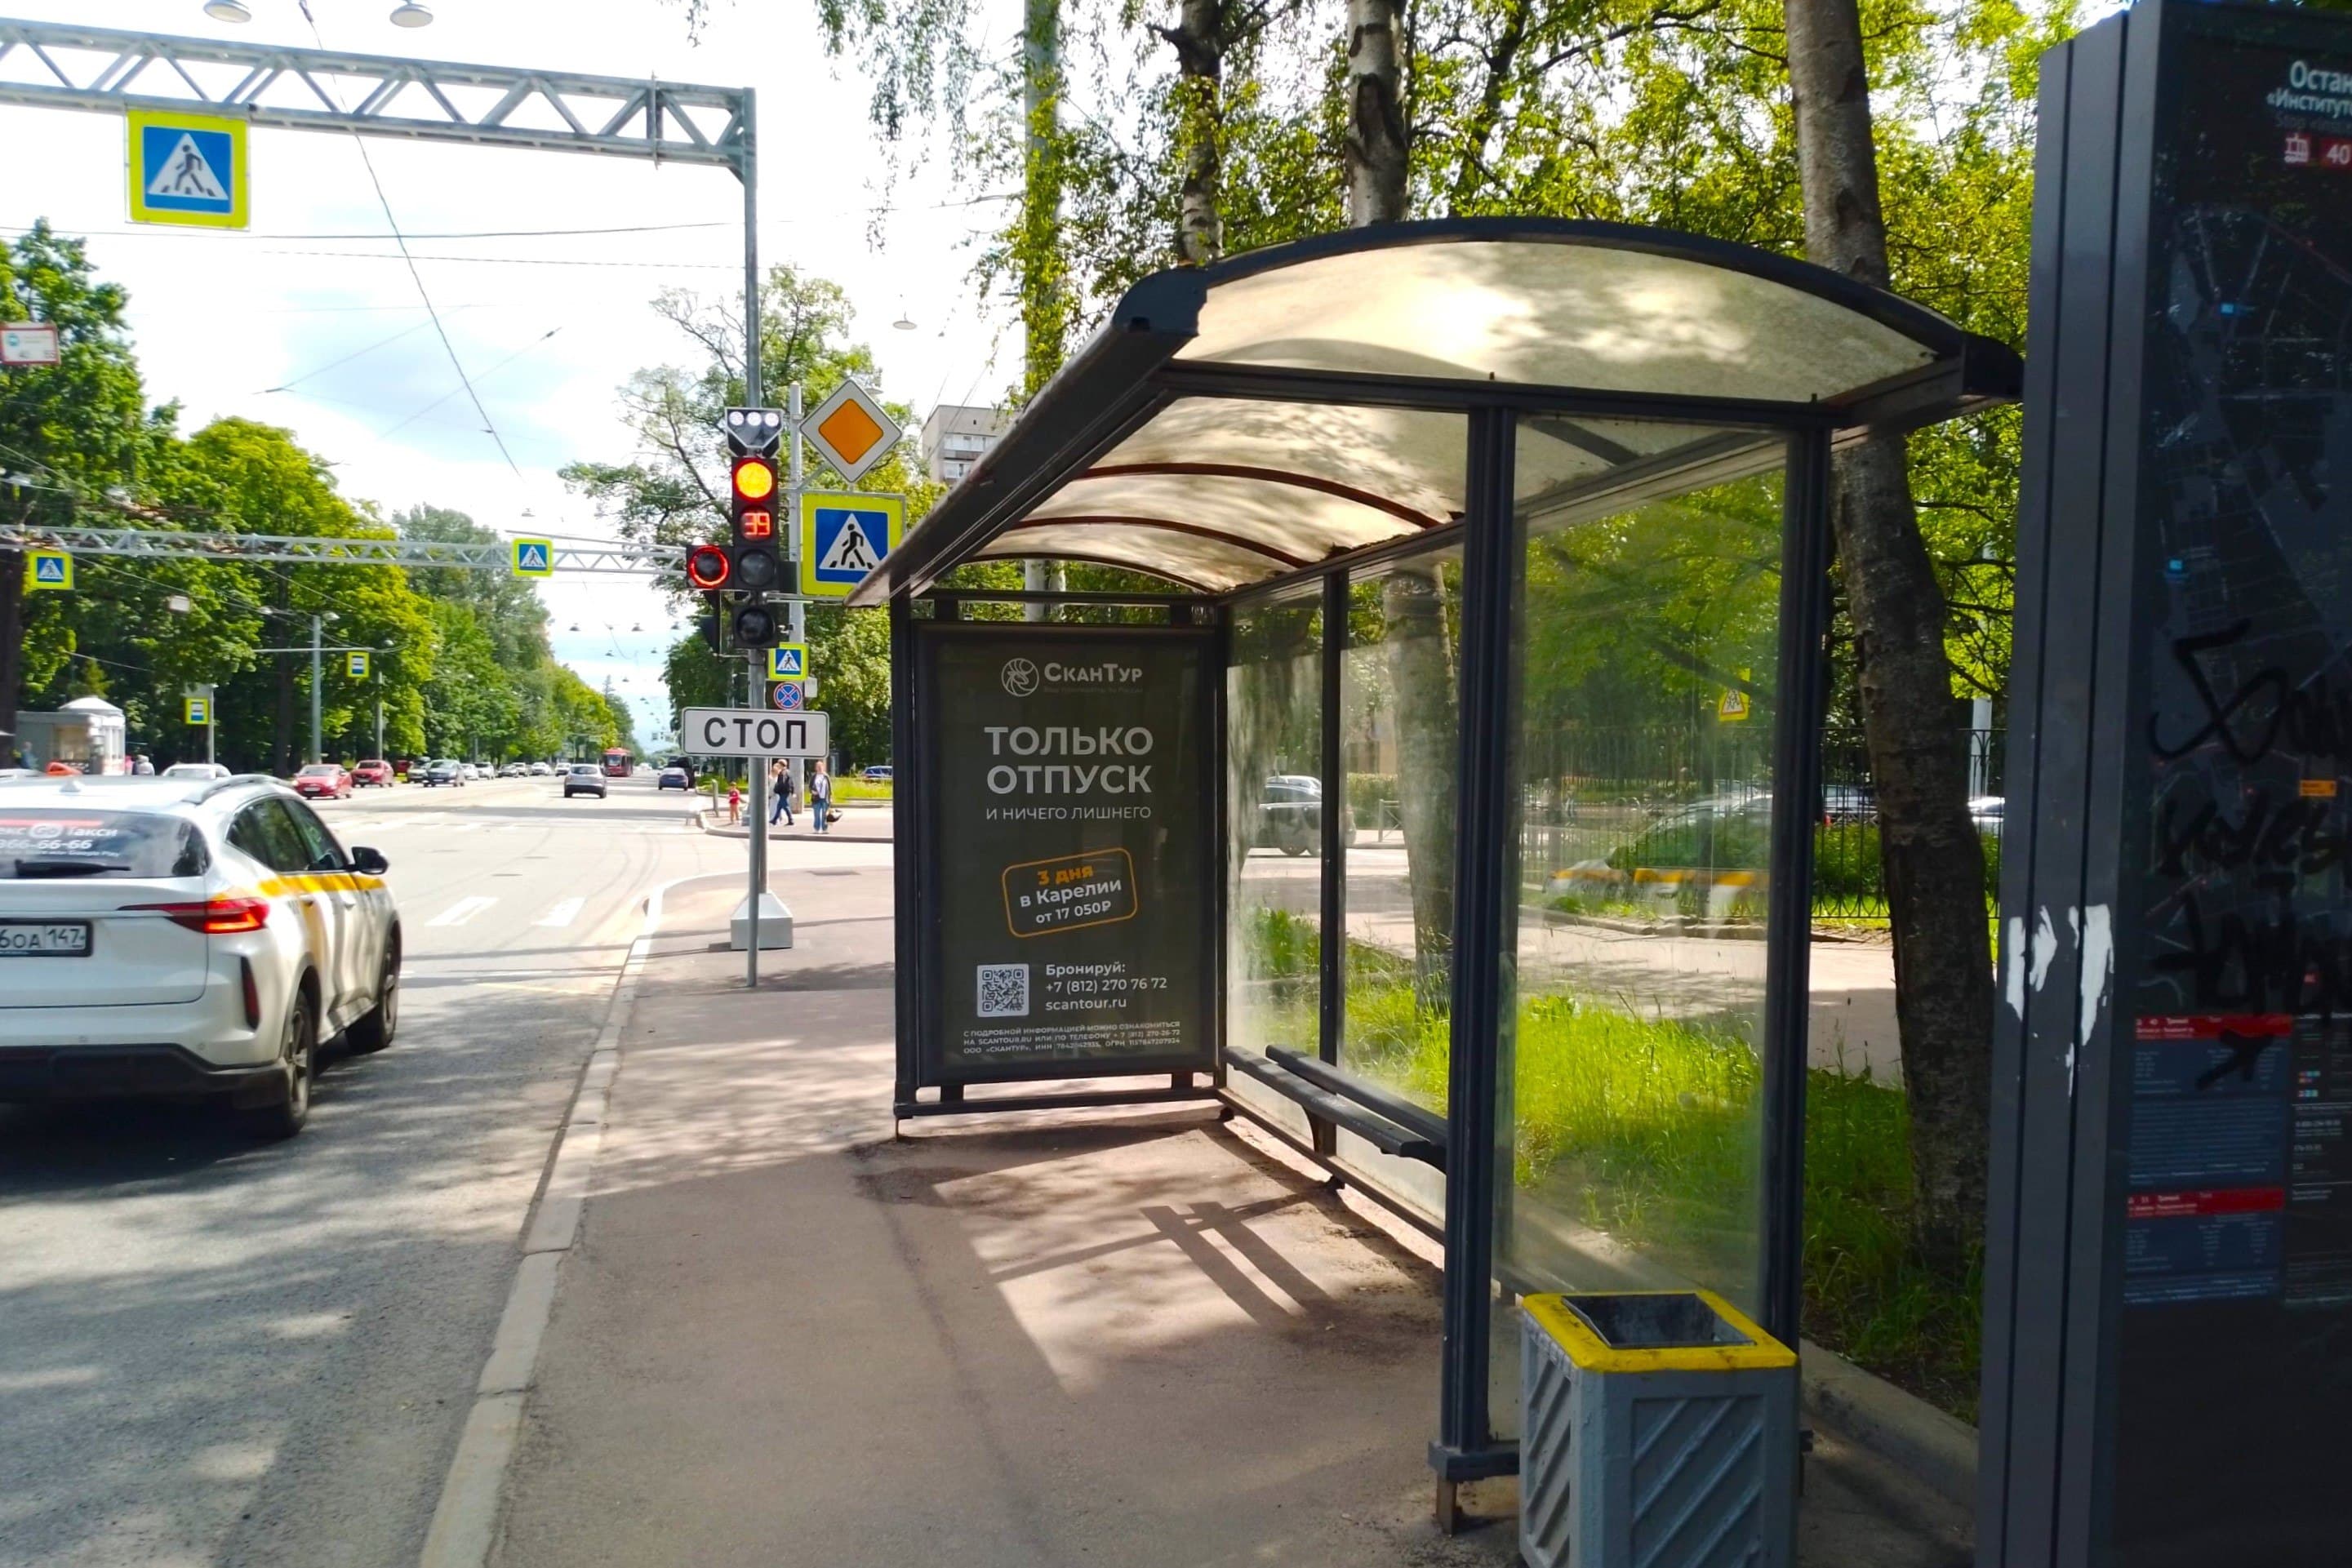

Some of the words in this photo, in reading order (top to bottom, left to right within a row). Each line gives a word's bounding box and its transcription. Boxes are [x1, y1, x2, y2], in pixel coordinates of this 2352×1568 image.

[2326, 143, 2351, 165] 40
[744, 512, 771, 536] 39
[704, 717, 807, 750] СТОП
[983, 726, 1154, 756] ТОЛЬКО
[986, 764, 1153, 795] ОТПУСК
[986, 807, 998, 821] И
[1002, 806, 1068, 821] НИЧЕГО
[1070, 806, 1152, 820] ЛИШНЕГО
[67, 826, 118, 837] Такси
[1037, 869, 1050, 886] 3
[1055, 864, 1095, 885] дня
[1020, 895, 1032, 908] в
[1036, 878, 1123, 905] Карелии
[1035, 913, 1052, 924] от
[1056, 907, 1069, 920] 17
[47, 928, 81, 948] 147
[1045, 961, 1127, 979] Бронируй:
[1045, 981, 1062, 993] +7
[1066, 979, 1098, 995] (812)
[1101, 979, 1127, 991] 270
[1130, 978, 1148, 990] 76
[1150, 977, 1168, 989] 72
[1045, 997, 1127, 1011] scantour.ru
[970, 1028, 1021, 1037] ПОДРОБНОЙ
[1023, 1025, 1085, 1034] ИНФОРМАЦИЕЙ
[1087, 1024, 1118, 1033] МОЖНО
[1118, 1021, 1180, 1031] ОЗНАКОМИТЬСЯ
[978, 1037, 1032, 1045] SCANTOUR.RU
[1054, 1033, 1067, 1042] ПО
[1069, 1032, 1111, 1041] ТЕЛЕФОНУ
[963, 1046, 982, 1055] ООО
